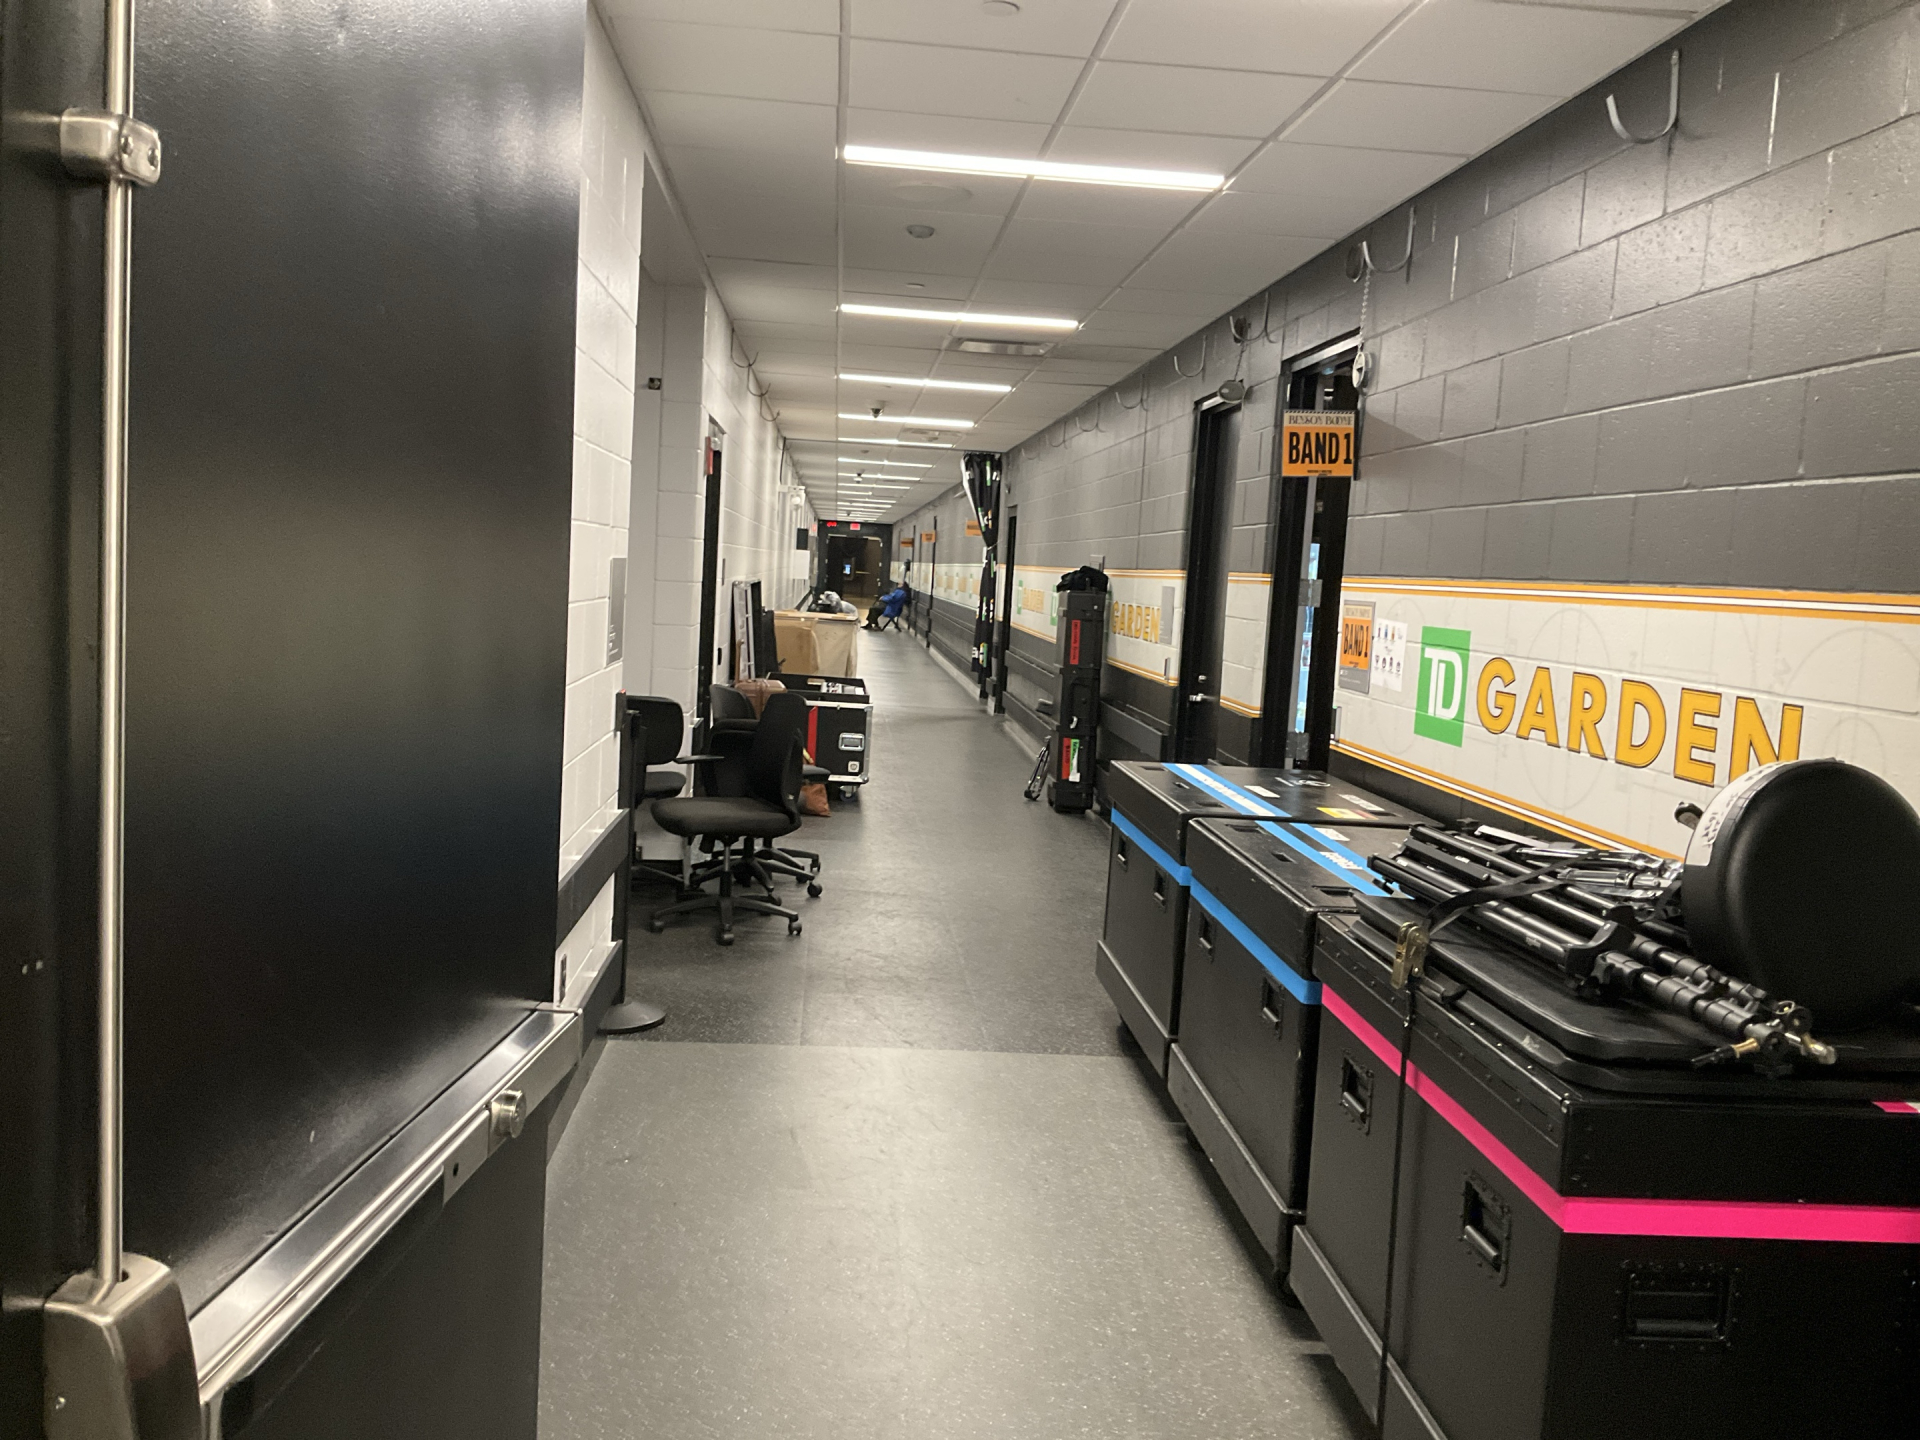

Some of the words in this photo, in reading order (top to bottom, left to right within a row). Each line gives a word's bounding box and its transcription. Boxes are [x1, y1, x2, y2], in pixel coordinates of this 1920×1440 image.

[1288, 431, 1339, 465] BAND
[1343, 432, 1353, 465] 1
[1112, 600, 1160, 644] GARDEN
[1343, 624, 1364, 656] BAND
[1424, 647, 1463, 720] TD
[1476, 656, 1804, 788] GARDEN
